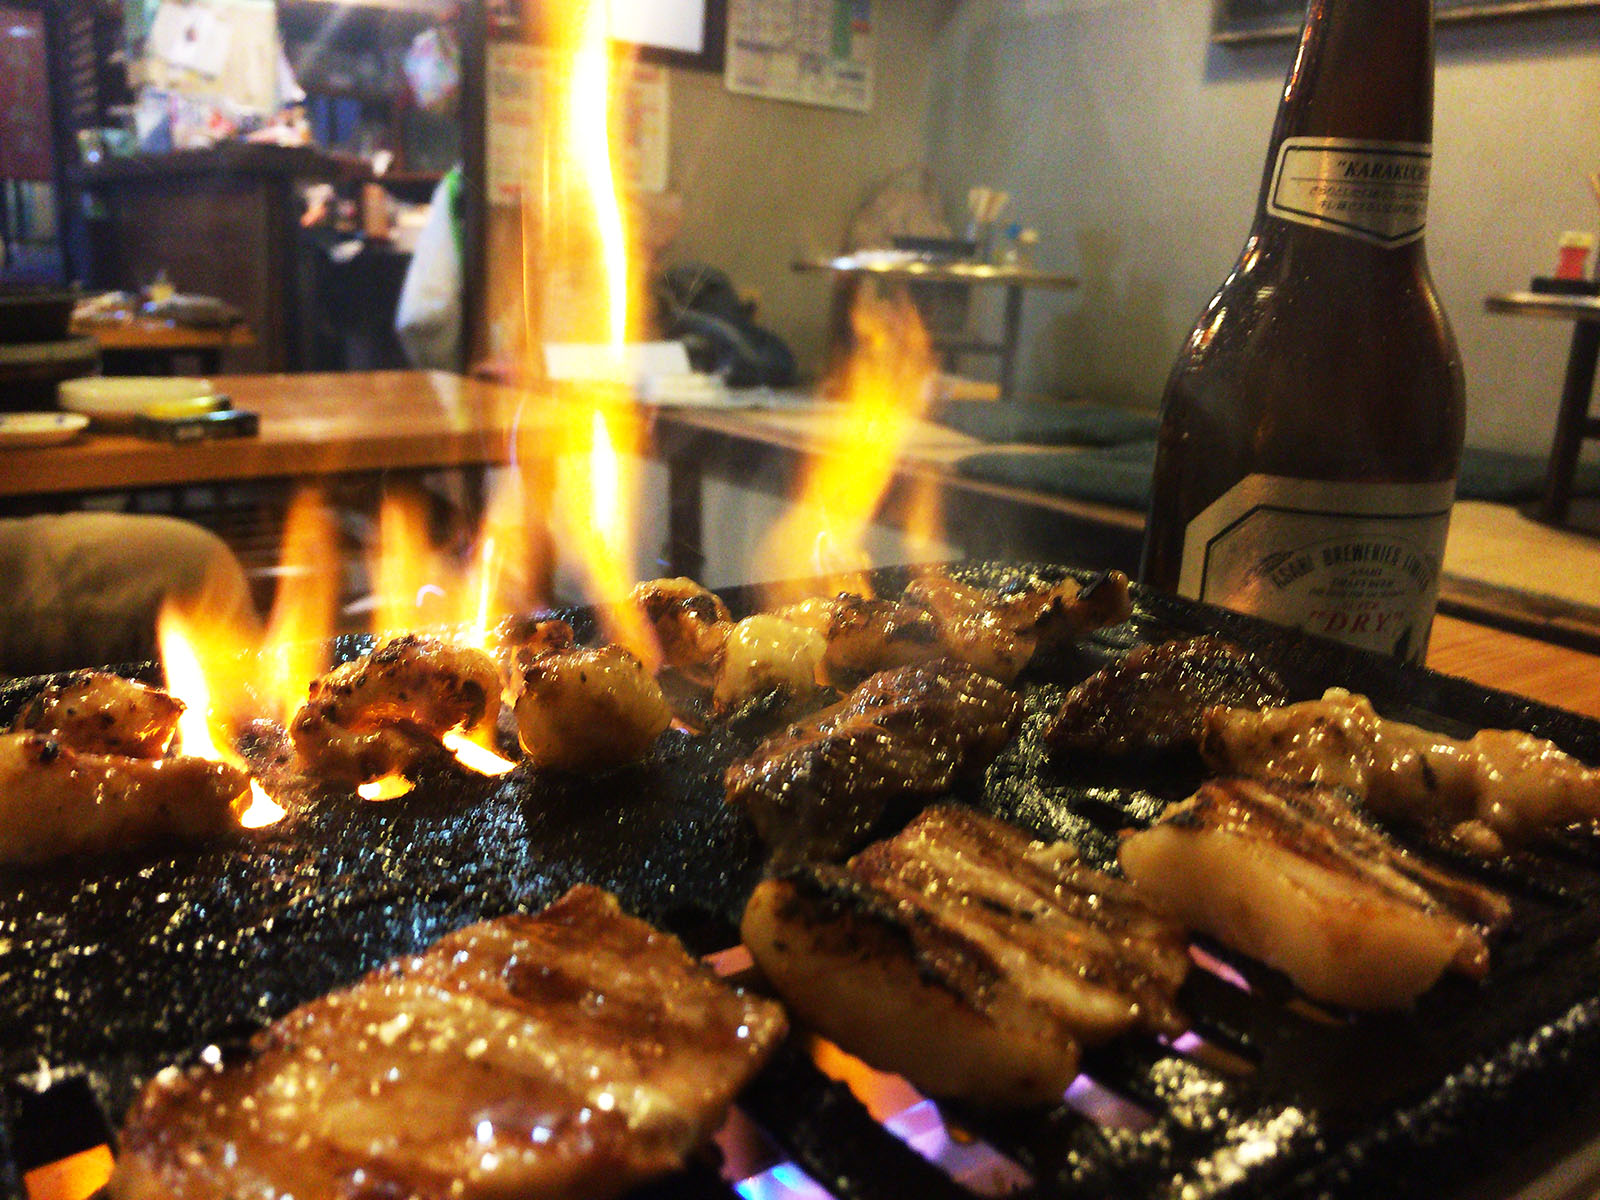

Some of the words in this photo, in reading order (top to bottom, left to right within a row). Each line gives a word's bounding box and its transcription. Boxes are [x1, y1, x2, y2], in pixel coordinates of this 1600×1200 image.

[1272, 552, 1315, 588] ASAHI
[1322, 543, 1402, 566] BREWERIES
[1311, 610, 1404, 633] "DRY"
